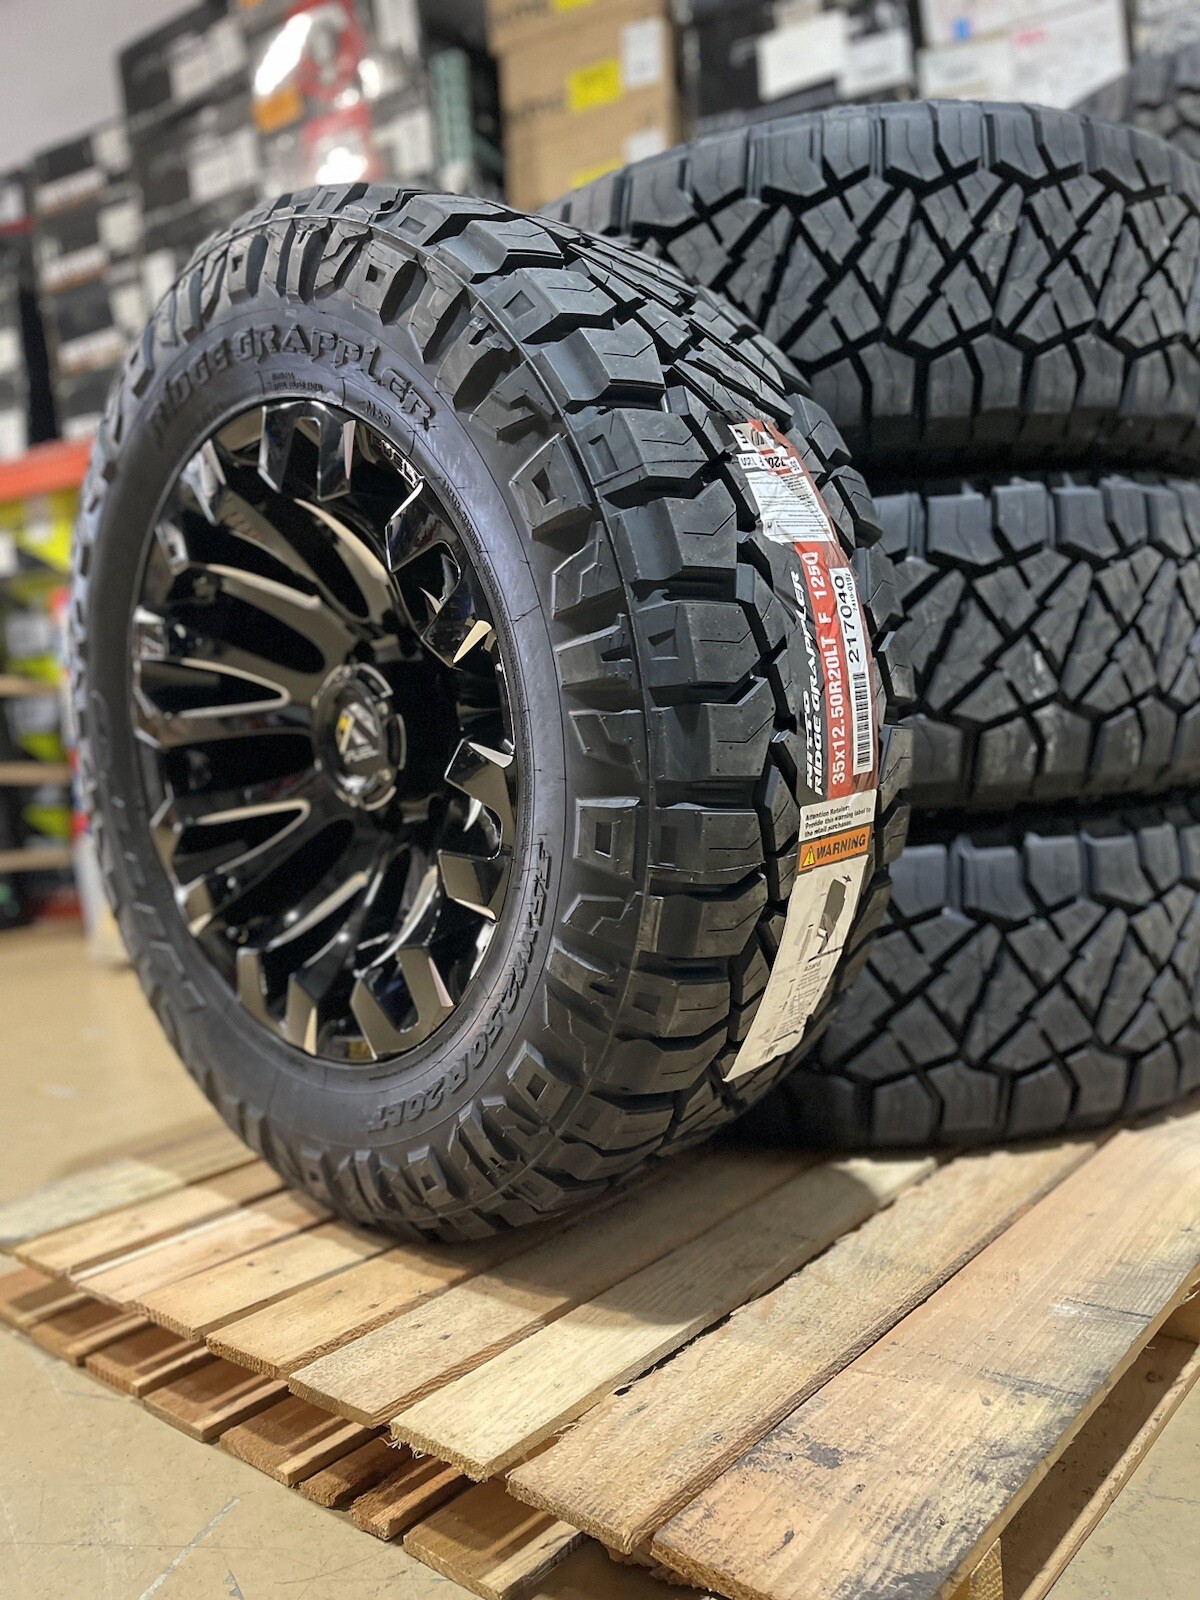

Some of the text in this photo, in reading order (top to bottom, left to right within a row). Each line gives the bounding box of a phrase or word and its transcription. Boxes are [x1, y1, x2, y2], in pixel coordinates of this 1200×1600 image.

[234, 323, 435, 429] GRAPPLER
[818, 612, 833, 625] F
[834, 575, 860, 664] 217040
[790, 569, 824, 796] RIDGE GRAPPLER
[820, 637, 846, 786] 35x12.50R20LT
[802, 690, 813, 789] NITTO
[804, 830, 813, 838] the
[813, 825, 827, 835] retail
[805, 810, 829, 821] Attention
[805, 820, 823, 830] Provide
[825, 817, 834, 825] this
[834, 812, 854, 823] warning
[854, 808, 866, 817] label
[816, 833, 866, 860] WARNING
